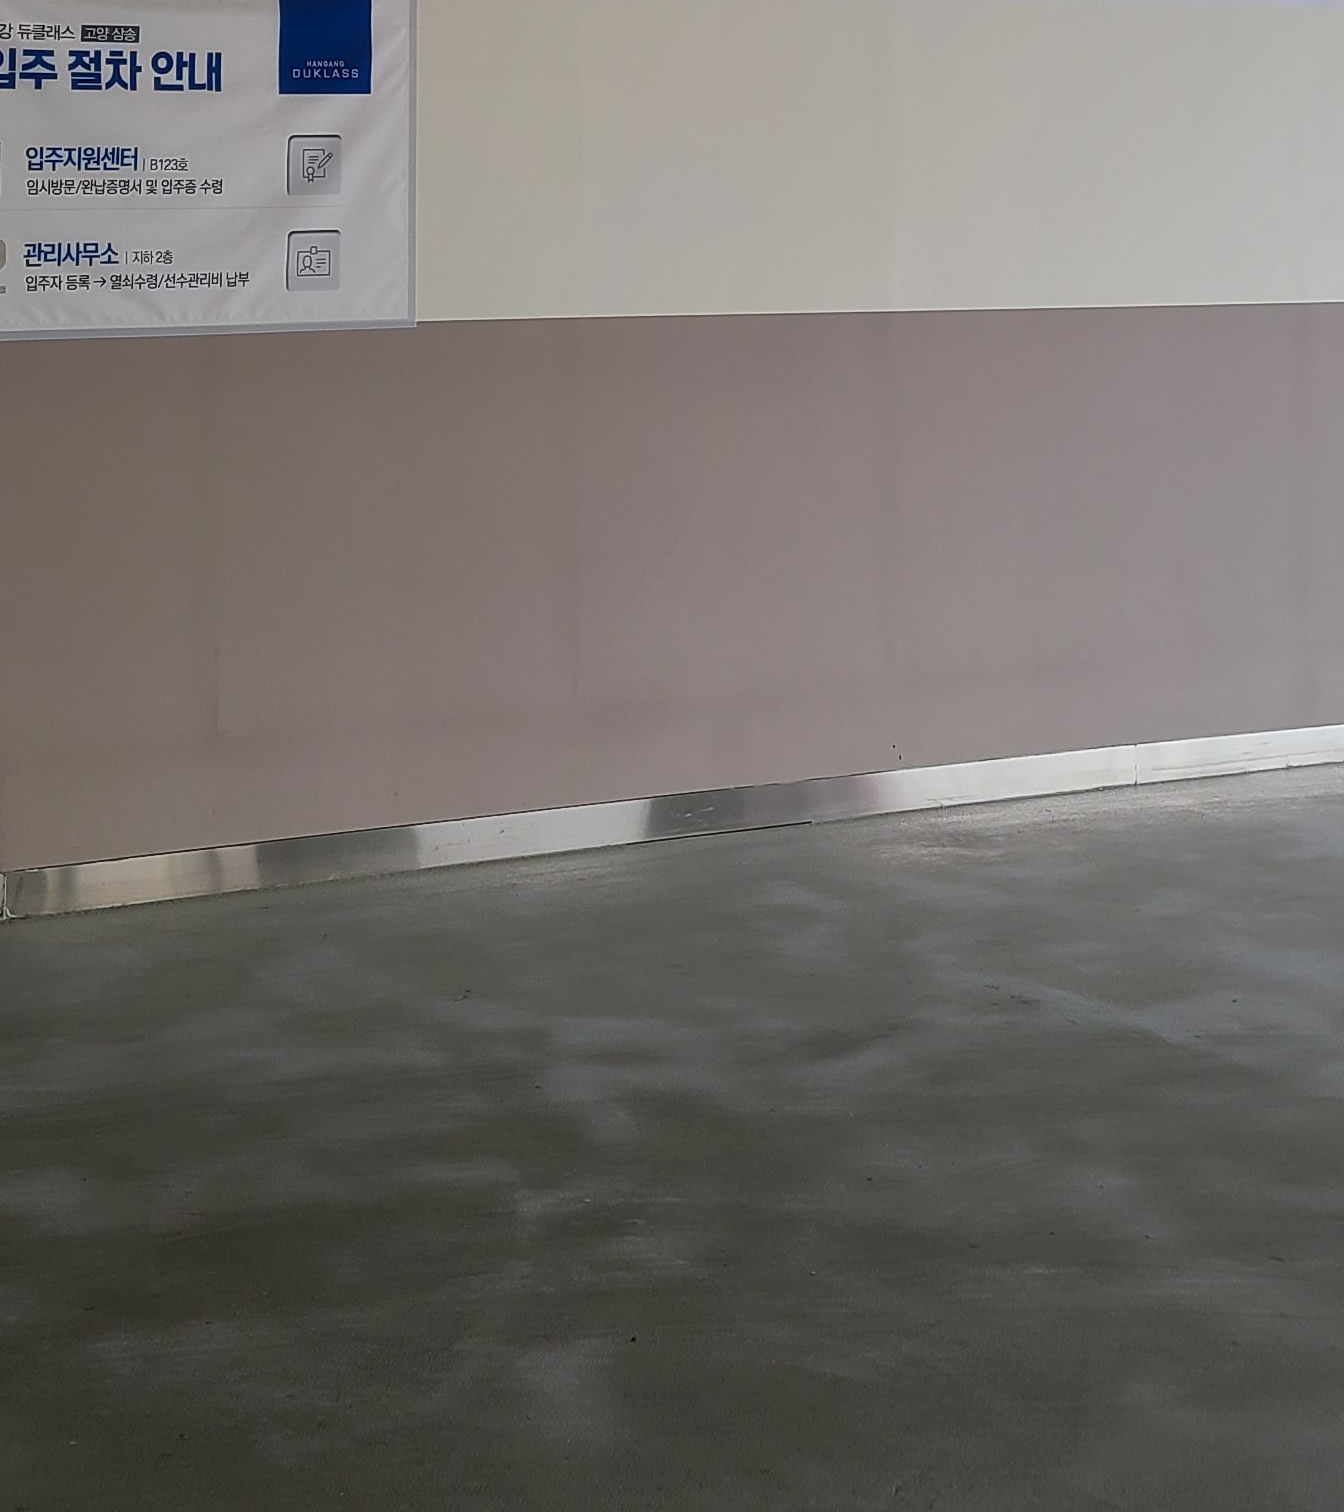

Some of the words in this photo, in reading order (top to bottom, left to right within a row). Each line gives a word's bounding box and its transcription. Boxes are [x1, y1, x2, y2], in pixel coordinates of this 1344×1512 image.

[16, 24, 75, 40] 듀클래스
[84, 27, 110, 41] 고양
[112, 28, 136, 41] 삼송
[68, 50, 142, 91] 절차
[151, 51, 222, 91] 안내
[293, 69, 359, 78] DUKLASS
[25, 147, 138, 171] 입주지원센터
[150, 158, 188, 171] B123호
[26, 178, 142, 195] 임시방문/완납증명서
[146, 180, 158, 195] 및
[161, 179, 196, 195] 입주증
[200, 180, 223, 195] 수령
[23, 243, 119, 267] 관리사무소
[132, 250, 153, 264] 지하
[156, 250, 173, 264] 2층
[26, 276, 62, 291] 입주자
[66, 275, 90, 290] 등록
[110, 273, 222, 289] 열쇠수령/선수관리비
[226, 272, 250, 288] 납부
